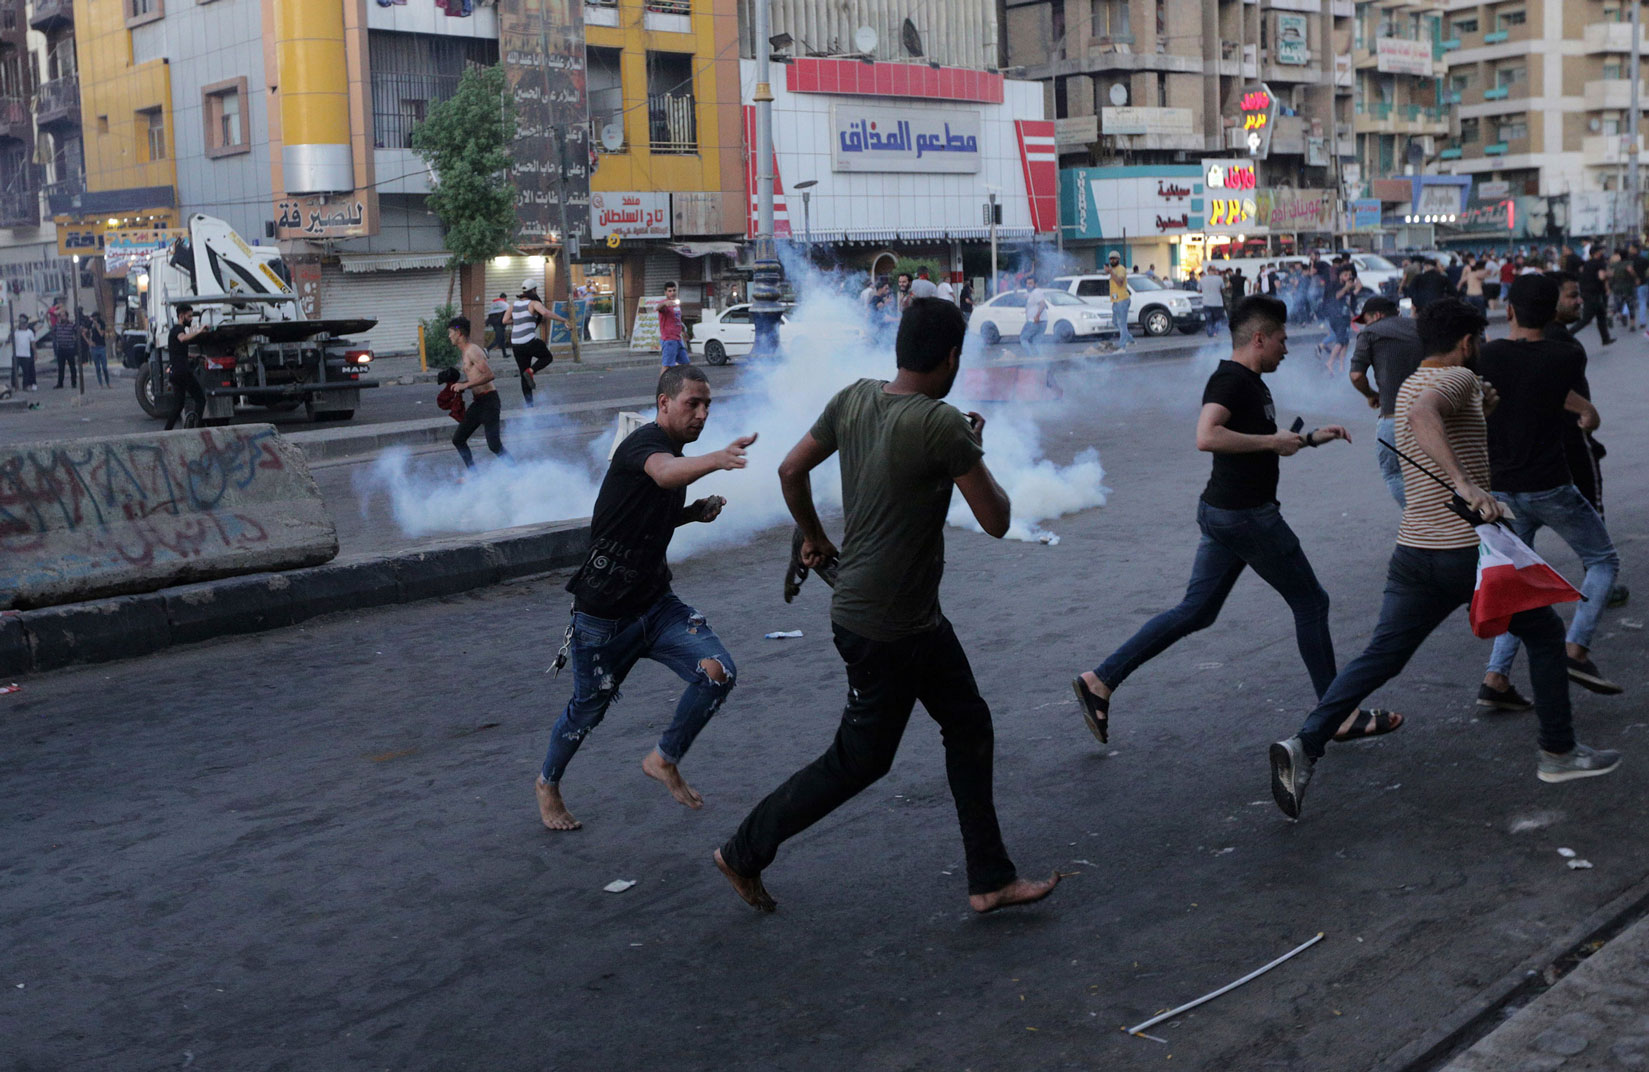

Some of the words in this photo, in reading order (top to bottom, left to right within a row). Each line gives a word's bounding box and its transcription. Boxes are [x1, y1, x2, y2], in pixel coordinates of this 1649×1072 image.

[1240, 90, 1270, 111] فلافل
[840, 118, 913, 152] المذاق
[916, 122, 978, 159] مطعم
[511, 159, 539, 177] الحسين
[1224, 164, 1256, 191] فلافل
[622, 194, 641, 206] منفذ
[279, 202, 363, 233] للصيرفة
[599, 208, 643, 227] السلطان
[646, 209, 664, 227] تاج
